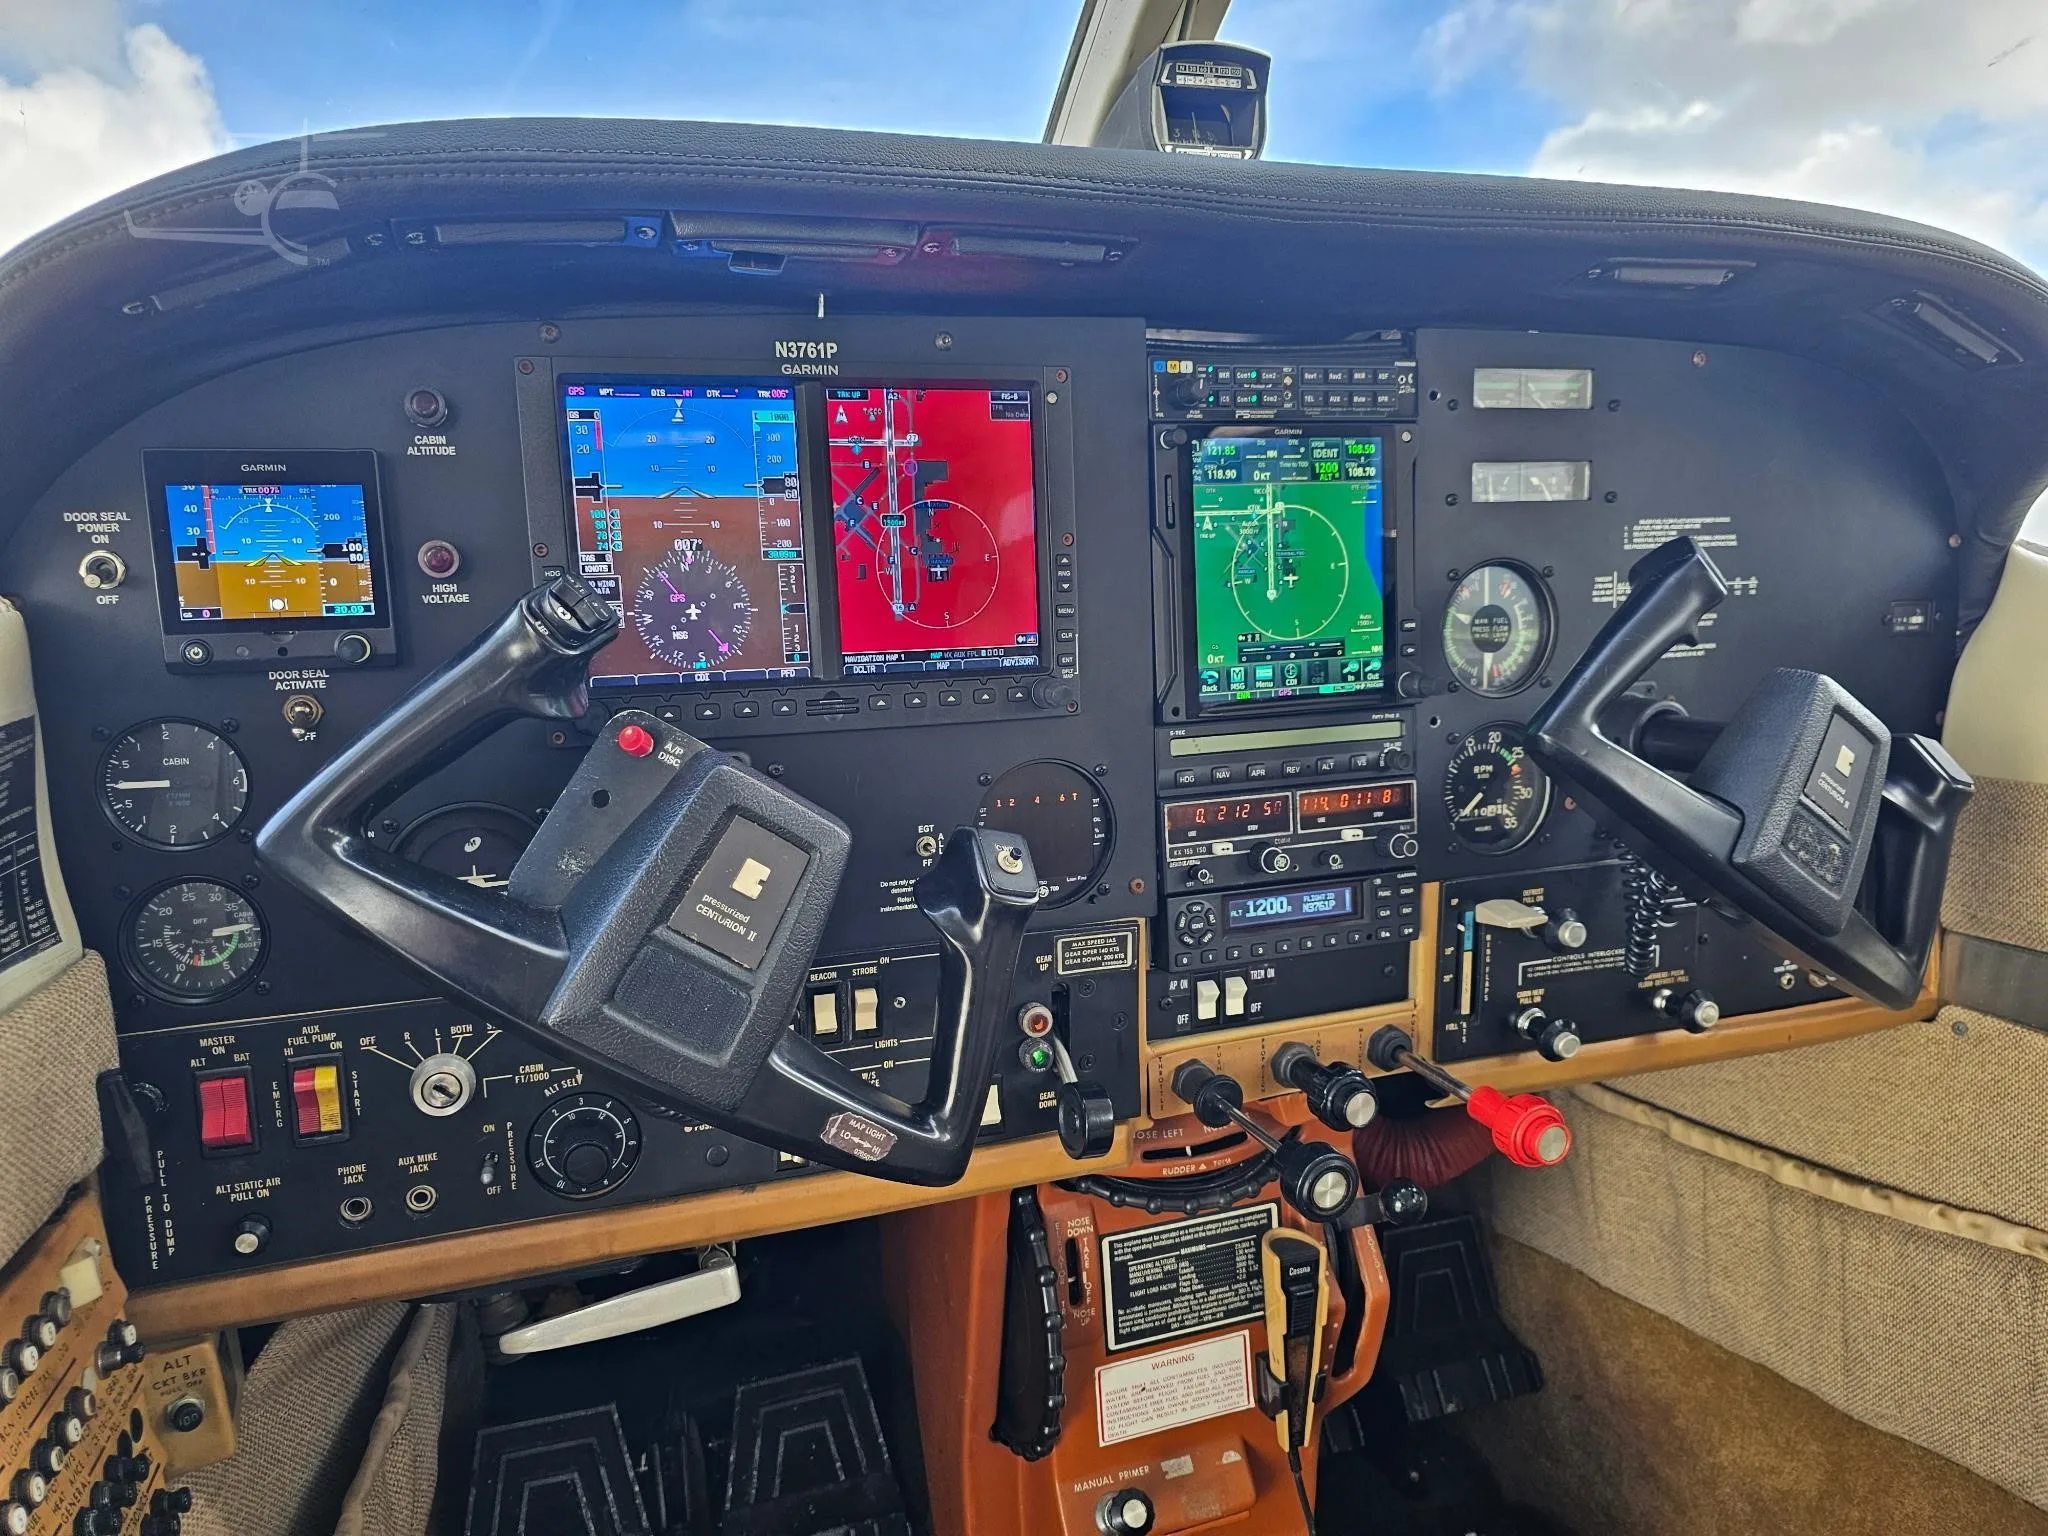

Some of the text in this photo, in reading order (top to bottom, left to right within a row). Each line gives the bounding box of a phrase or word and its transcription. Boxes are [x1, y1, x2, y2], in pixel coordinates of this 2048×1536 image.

[776, 341, 838, 359] N3761P
[781, 364, 839, 376] GARMIN
[568, 386, 585, 396] GPS
[600, 388, 614, 397] WPT
[651, 389, 666, 397] DIS
[414, 436, 447, 446] CABIN
[407, 446, 457, 456] ALTITUDE
[1207, 446, 1236, 456] 121.85
[1314, 448, 1339, 459] IDENT
[241, 464, 287, 472] GARMIN
[1314, 462, 1339, 474] 1200
[1208, 470, 1237, 480] 118.90
[64, 512, 131, 523] DOOR SEAL
[76, 522, 120, 533] POWER
[92, 534, 110, 545] ON
[432, 584, 458, 594] HIGH
[96, 595, 119, 605] OFF
[422, 594, 470, 605] VOLTAGE
[670, 594, 686, 603] GPS
[673, 631, 689, 640] MSG
[845, 655, 885, 663] NAVIGATION
[886, 654, 899, 662] MAP
[1003, 657, 1035, 667] ADVISORY
[1062, 656, 1073, 664] ENT
[854, 665, 876, 674] DCLTR
[936, 662, 950, 670] MAP
[268, 670, 330, 680] DOOR SEAL
[695, 673, 710, 682] CDI
[780, 670, 796, 678] PFD
[275, 679, 327, 690] ACTIVATE
[1202, 684, 1218, 693] Back
[1230, 682, 1246, 690] MSG
[1256, 680, 1274, 688] Menu
[664, 742, 684, 756] A/P
[658, 751, 681, 768] DISC
[1357, 758, 1367, 767] VS
[1286, 766, 1300, 774] REV
[1322, 762, 1335, 770] ALT
[1474, 764, 1493, 774] RPM
[1216, 771, 1231, 779] NAV
[1251, 768, 1266, 777] APR
[1180, 776, 1195, 784] HDG
[918, 825, 935, 833] EGT
[922, 859, 933, 867] FF
[702, 894, 750, 923] pressurized
[1302, 900, 1336, 913] N3761P
[696, 904, 747, 936] CENTURION
[1184, 936, 1194, 945] OFF
[1064, 950, 1081, 958] GEAR
[880, 956, 890, 965] ON
[1036, 955, 1053, 964] GEAR
[1082, 956, 1102, 964] DOWN
[852, 966, 878, 976] STROBE
[1250, 968, 1275, 980] TRIM ON
[810, 971, 837, 982] BEACON
[1170, 980, 1189, 991] AP ON
[1251, 1002, 1262, 1013] OFF
[1178, 1014, 1189, 1025] OFF
[302, 1025, 320, 1035] AUX
[451, 1024, 473, 1035] BOTH
[288, 1032, 337, 1046] FUEL PUMP
[404, 1032, 411, 1040] R
[200, 1036, 236, 1047] MASTER
[330, 1041, 343, 1050] ON
[360, 1036, 376, 1047] OFF
[875, 1038, 898, 1049] LIGHTS
[212, 1046, 225, 1055] ON
[284, 1048, 294, 1056] HI
[234, 1052, 250, 1063] BAT
[190, 1058, 207, 1068] ALT
[884, 1060, 894, 1069] ON
[520, 1064, 544, 1074] CABIN
[515, 1072, 550, 1084] FT/1000
[862, 1072, 876, 1081] W/S
[544, 1078, 578, 1097] ALT SEL
[352, 1071, 361, 1116] START
[1040, 1092, 1056, 1102] GEAR
[272, 1082, 283, 1128] EMERG
[1039, 1099, 1057, 1109] DOWN
[483, 1124, 495, 1133] ON
[849, 1119, 887, 1142] MAP LIGHT
[1164, 1128, 1184, 1138] LEFT
[840, 1130, 851, 1140] LO
[872, 1146, 881, 1155] HI
[398, 1152, 439, 1167] AUX MIKE
[506, 1122, 517, 1190] PRESSURE
[338, 1164, 367, 1176] PHONE
[409, 1163, 429, 1174] JACK
[1162, 1164, 1196, 1176] RUDDER
[344, 1174, 364, 1185] JACK
[216, 1177, 281, 1195] ALT STATIC AIR
[487, 1186, 502, 1195] OFF
[230, 1188, 270, 1202] PULL ON
[158, 1151, 175, 1256] PULL TO DUMP
[1068, 1216, 1091, 1229] NOSE
[145, 1196, 159, 1270] PRESSURE
[1068, 1226, 1094, 1238] DOWN
[1289, 1266, 1311, 1277] Cessna
[1130, 1288, 1146, 1298] FLIGHT
[162, 1354, 192, 1372] ALT
[1152, 1354, 1195, 1370] WARNING
[152, 1368, 207, 1391] CKT BKR
[1074, 1464, 1150, 1493] MANUAL PRIMER
